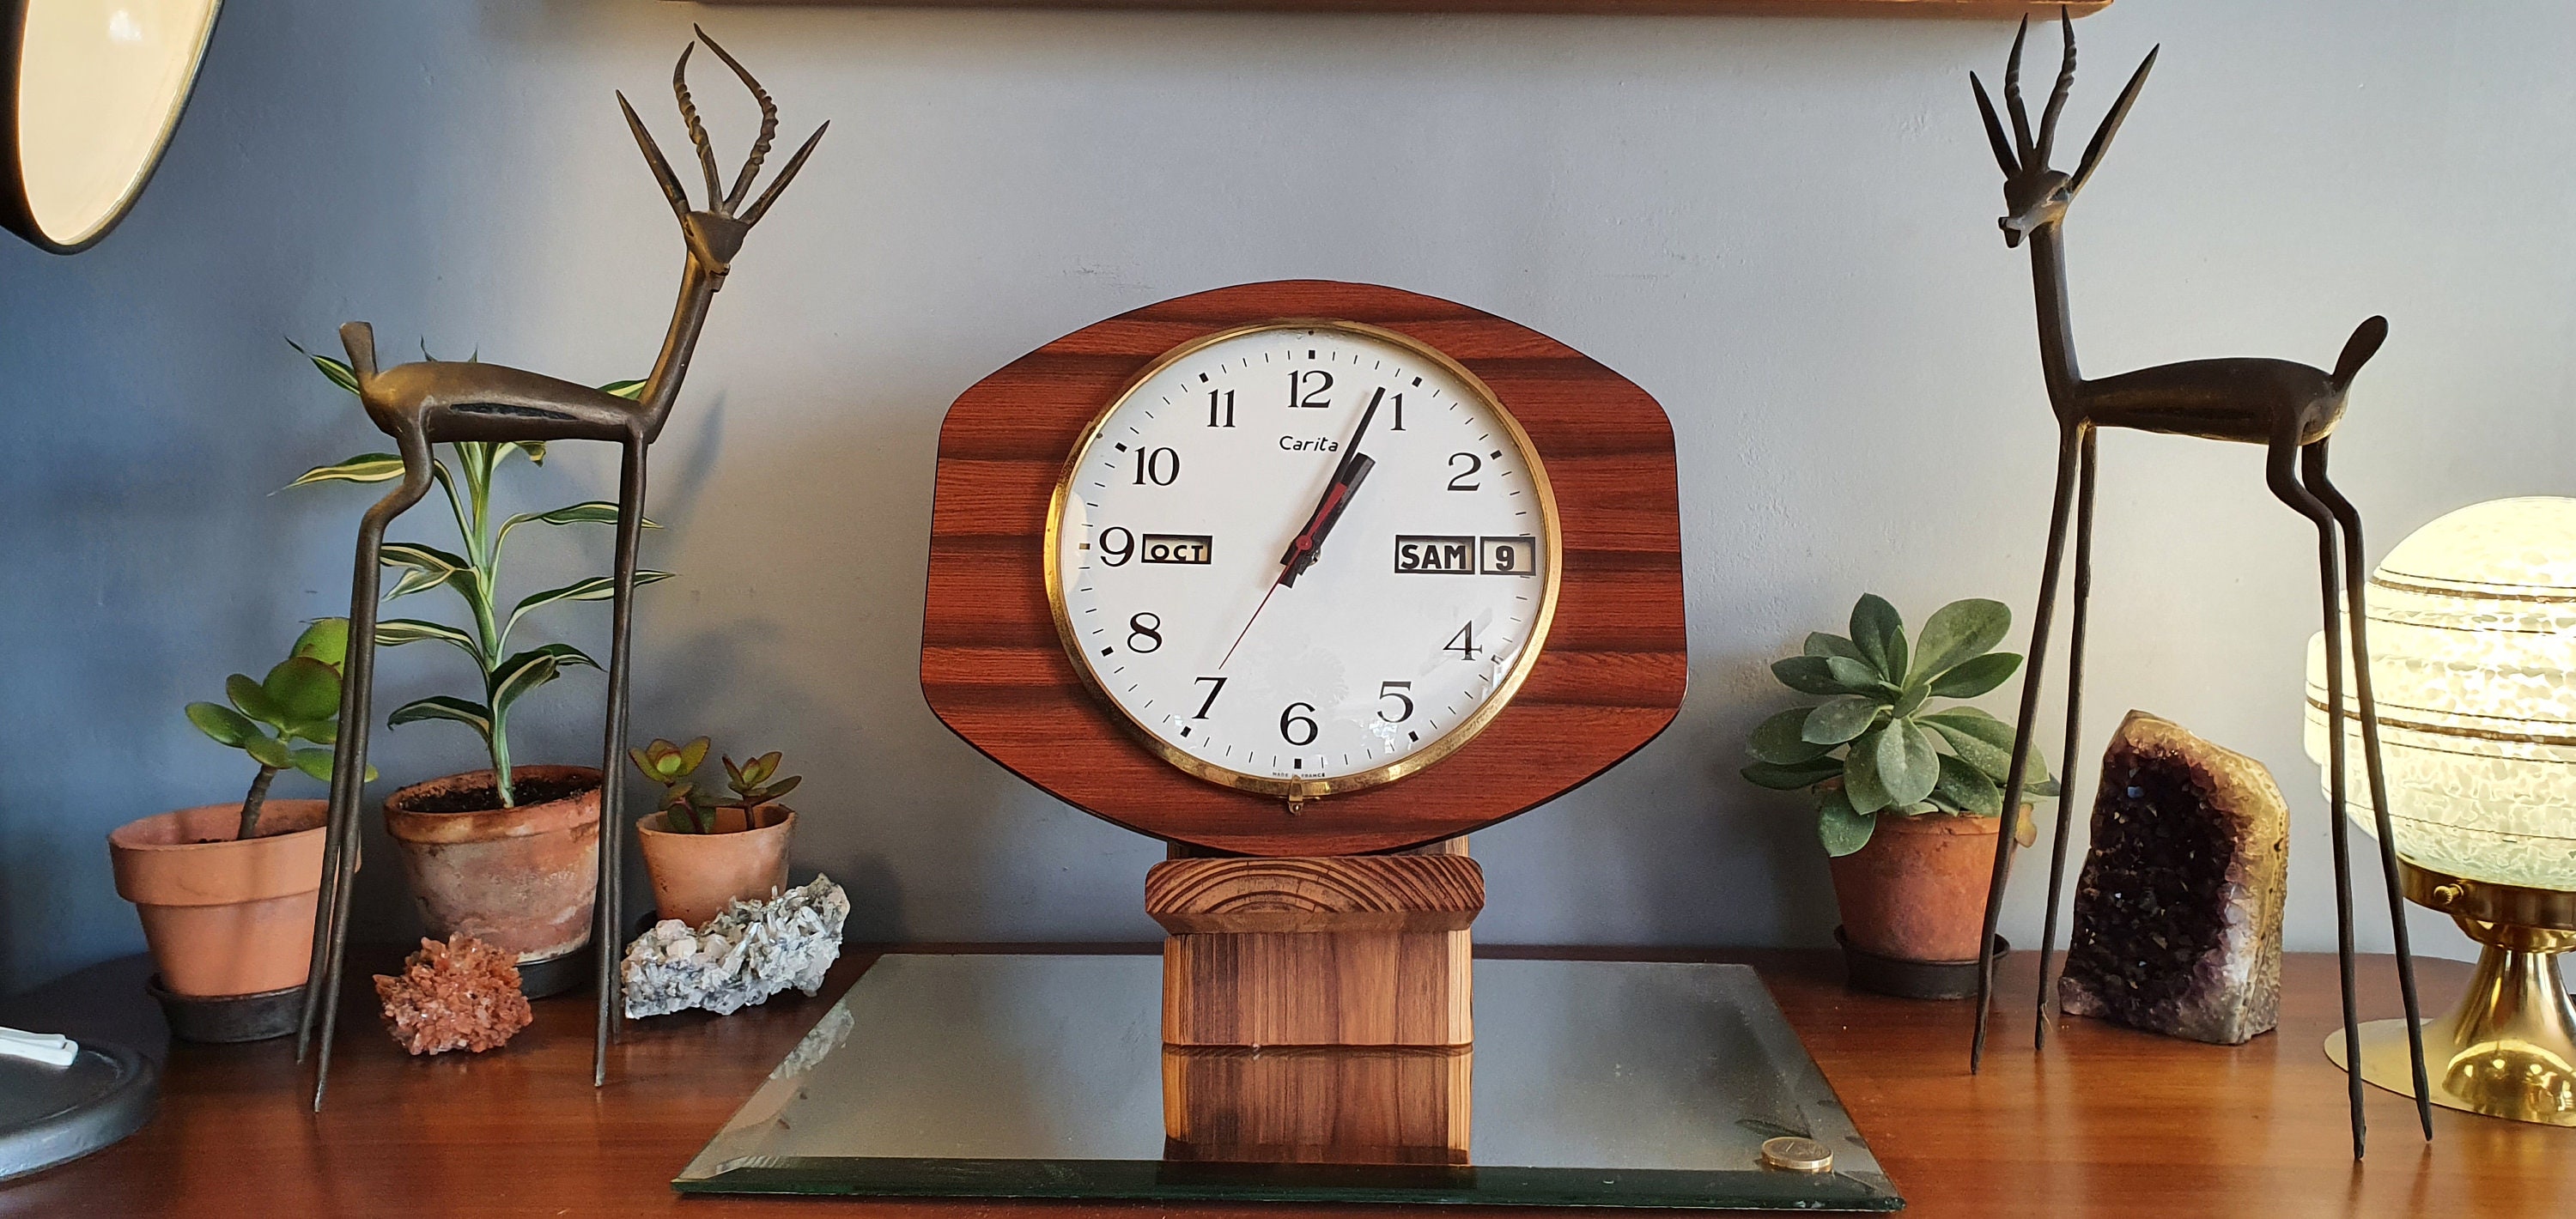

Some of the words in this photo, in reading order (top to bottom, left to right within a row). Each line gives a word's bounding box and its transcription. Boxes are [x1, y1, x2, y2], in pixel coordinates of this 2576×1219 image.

[1207, 389, 1236, 428] 11
[1287, 370, 1334, 409] 12
[1389, 392, 1407, 431] 1
[1279, 435, 1339, 452] Carita
[1132, 446, 1180, 487] 10
[1448, 452, 1481, 492] 2
[1099, 526, 1135, 567] 9
[1150, 544, 1206, 561] OCT
[1400, 543, 1467, 571] SAM
[1496, 543, 1515, 571] 9
[1127, 612, 1163, 653] 8
[1443, 621, 1483, 661] 4
[1194, 676, 1227, 719] 7
[1377, 681, 1413, 723] 5
[1280, 702, 1318, 746] 6
